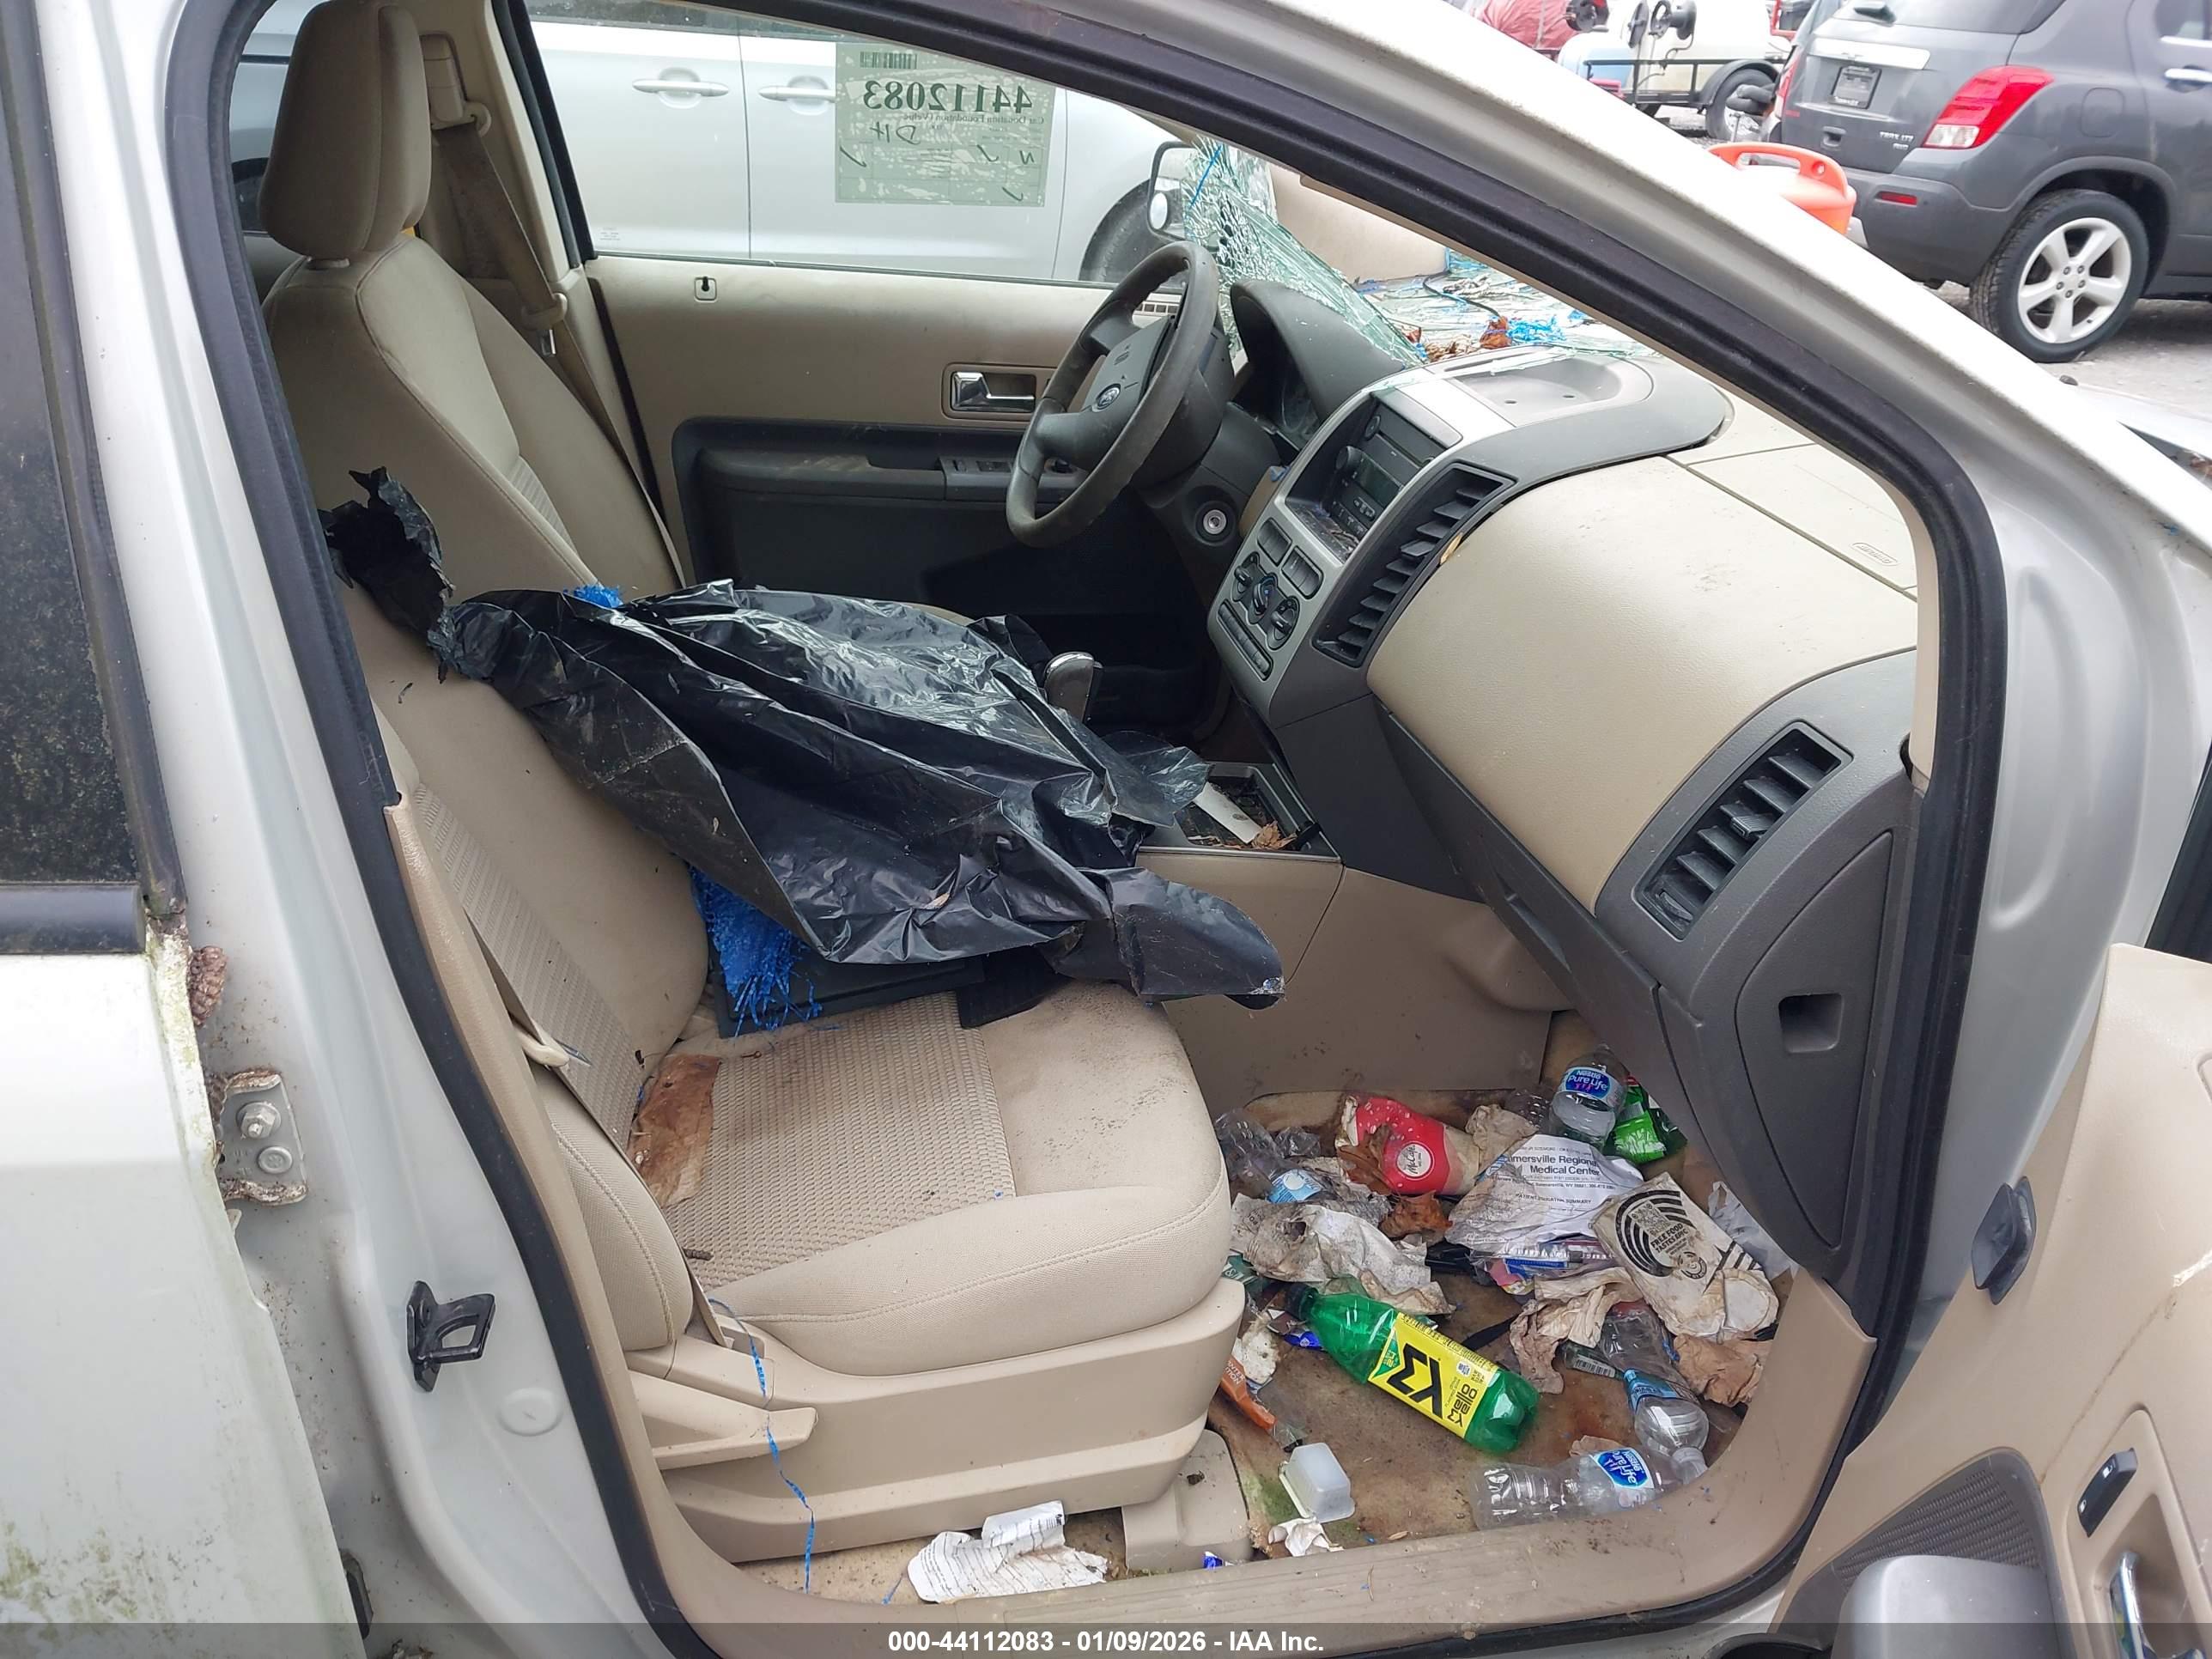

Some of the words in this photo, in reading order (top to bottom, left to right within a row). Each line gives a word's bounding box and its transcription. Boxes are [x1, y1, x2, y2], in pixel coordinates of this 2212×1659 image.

[1568, 1074, 1590, 1084] Pure
[1590, 1079, 1607, 1091] Life
[1530, 1165, 1566, 1174] Medical
[1568, 1166, 1600, 1176] Center
[1650, 1233, 1668, 1248] FREE
[1666, 1223, 1683, 1237] FOOD
[1656, 1236, 1675, 1253] TASTES
[1674, 1228, 1689, 1240] EPIC
[1620, 1464, 1637, 1484] Life
